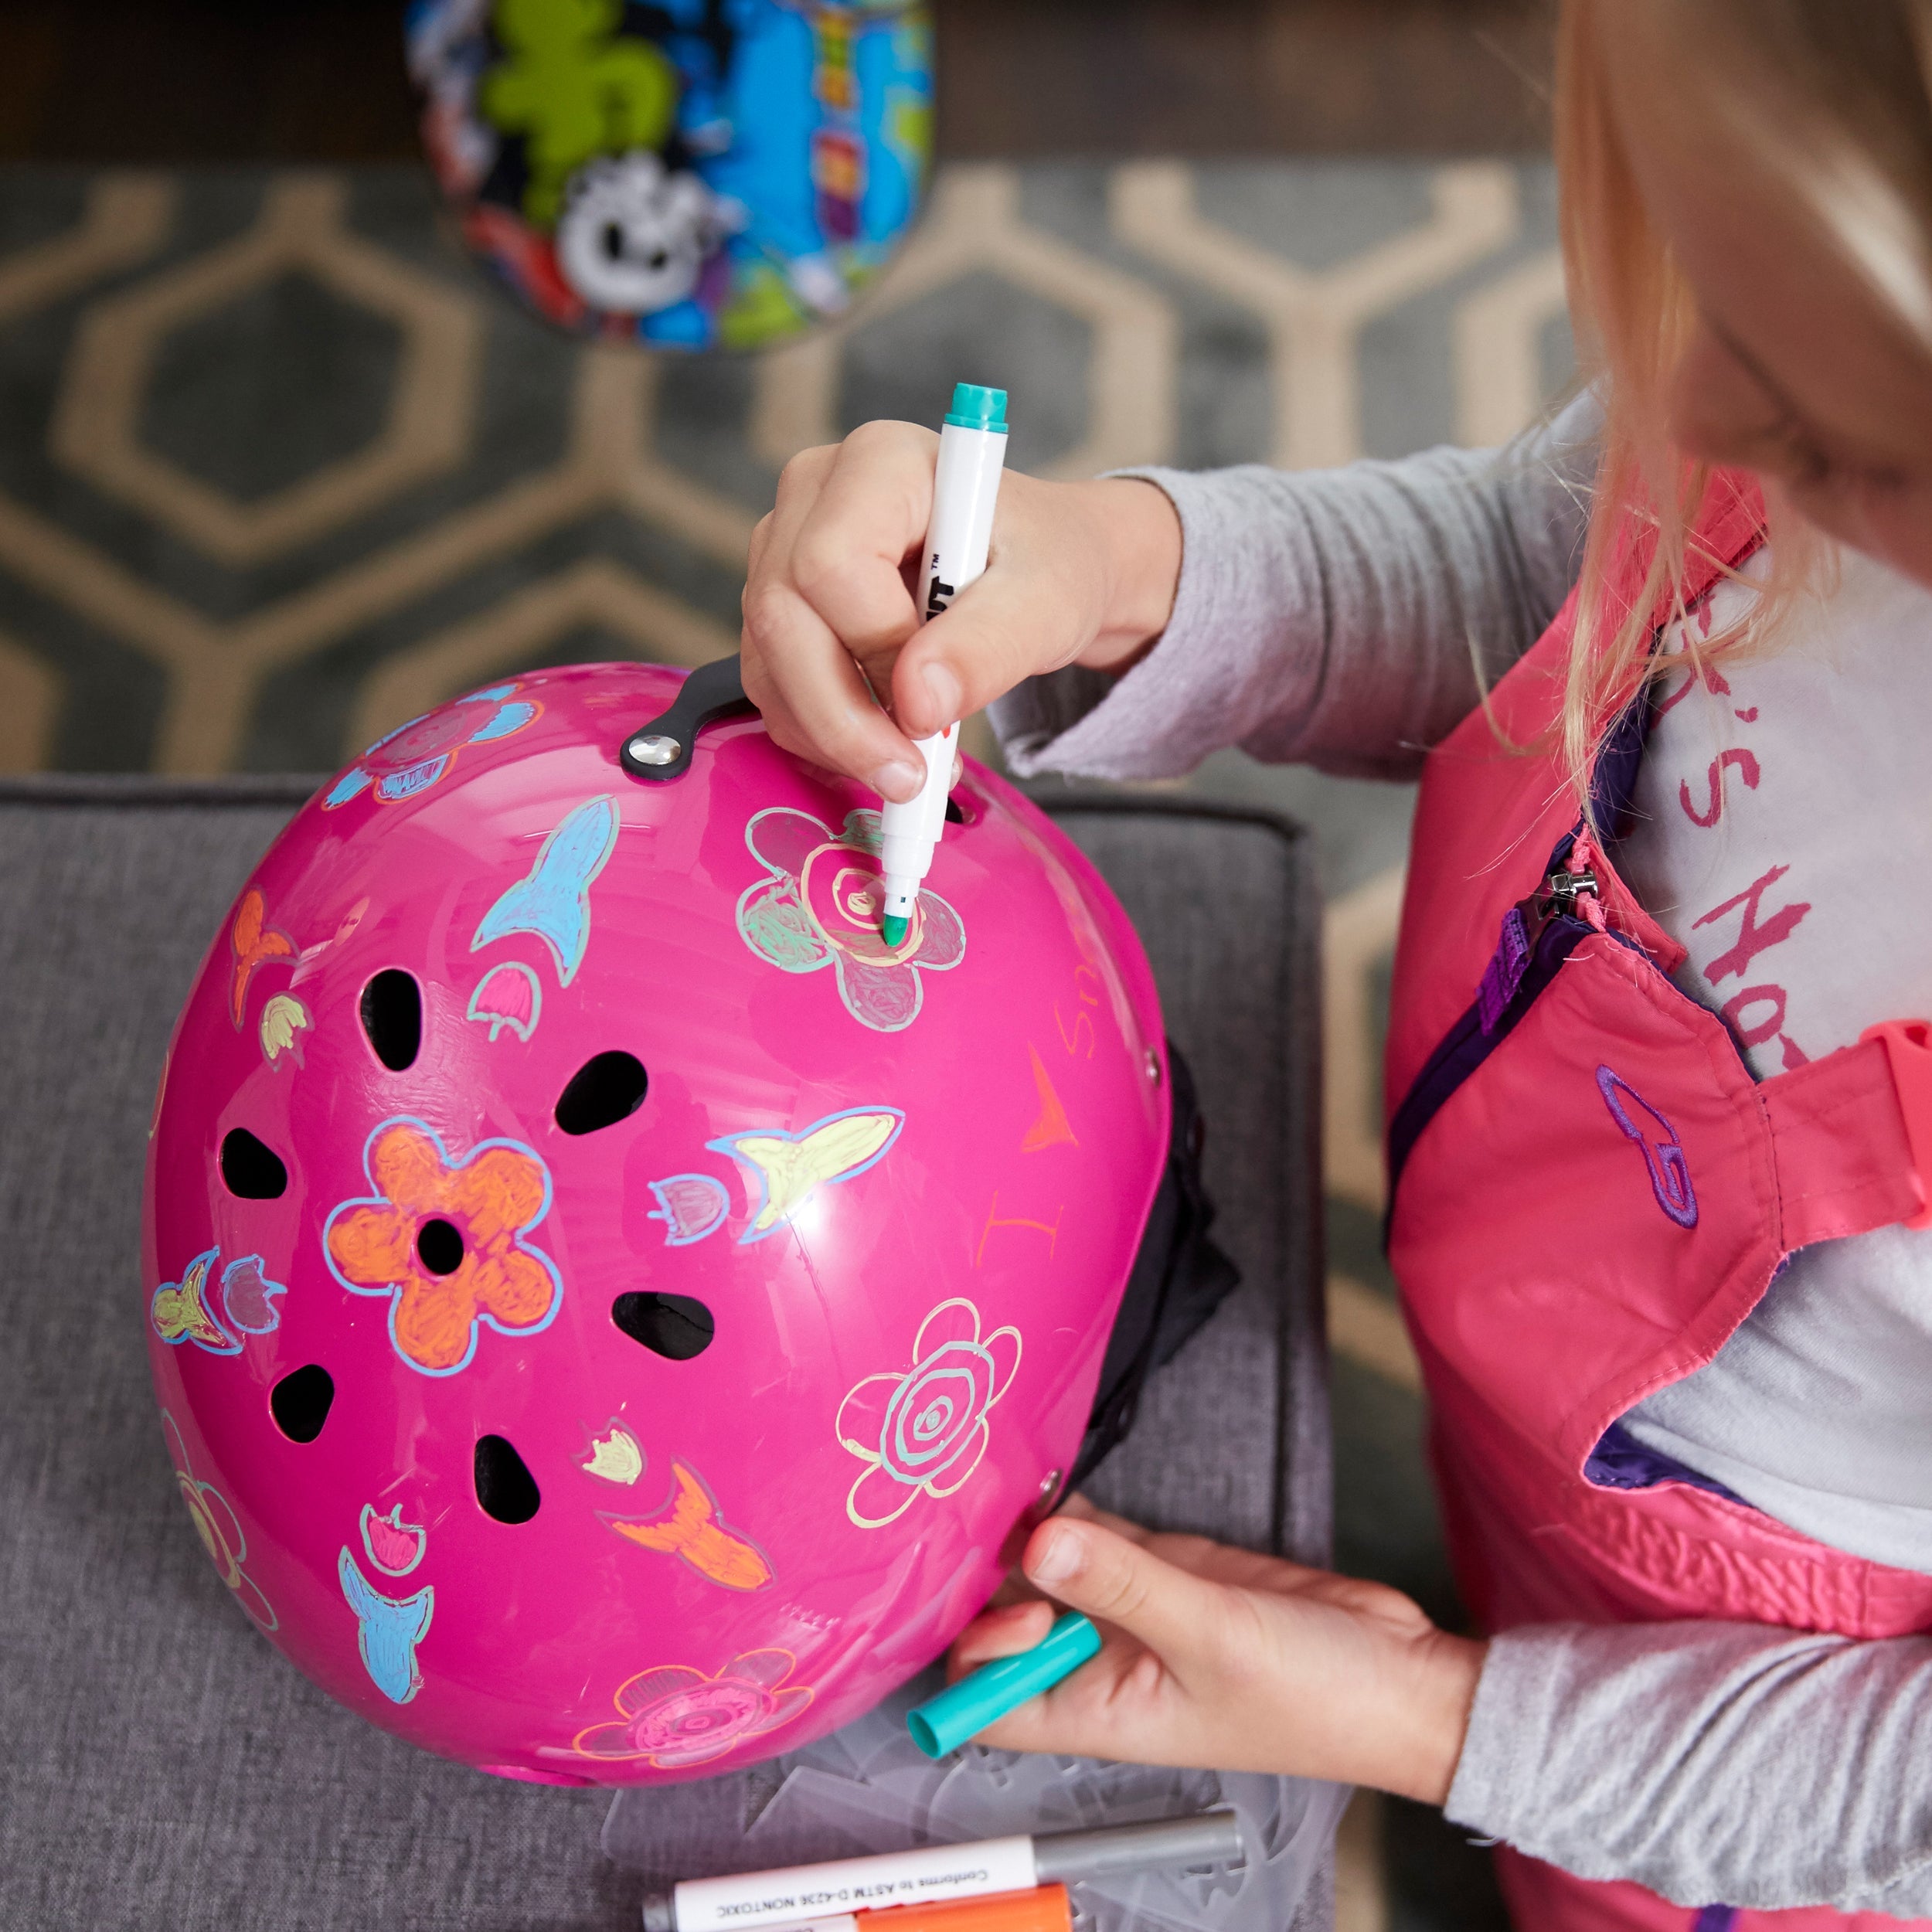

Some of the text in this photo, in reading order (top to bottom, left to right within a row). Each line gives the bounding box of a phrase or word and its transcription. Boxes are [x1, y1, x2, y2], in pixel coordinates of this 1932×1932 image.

[919, 1869, 988, 1887] Conforms
[854, 1883, 897, 1898] ASTM
[899, 1882, 913, 1892] to
[716, 1896, 794, 1917] NONTOXIC
